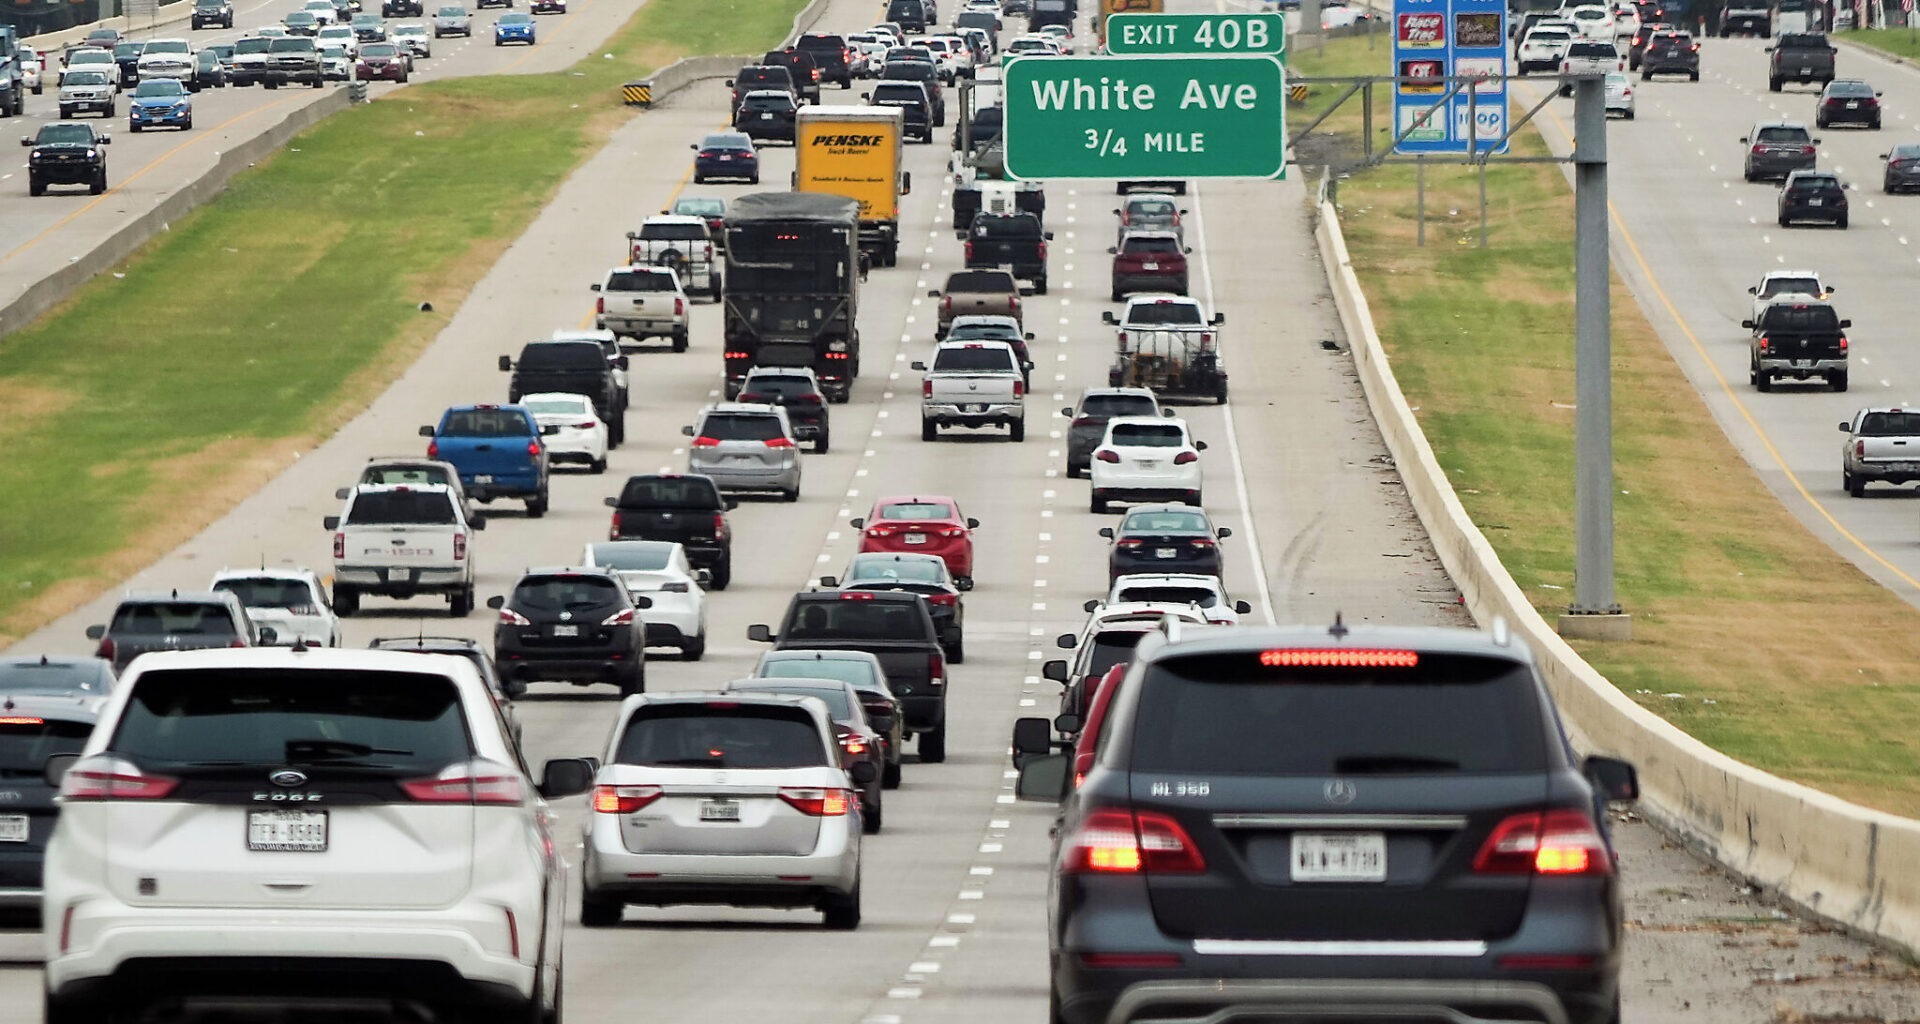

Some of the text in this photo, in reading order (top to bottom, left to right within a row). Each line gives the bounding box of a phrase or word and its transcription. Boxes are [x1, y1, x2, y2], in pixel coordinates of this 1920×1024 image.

[1404, 15, 1441, 28] Race
[1123, 20, 1269, 48] EXIT 40B
[1031, 78, 1257, 110] White Ave
[811, 135, 884, 146] PENSKE
[1085, 129, 1204, 157] 3/4 MILE
[253, 792, 323, 801] EDGE
